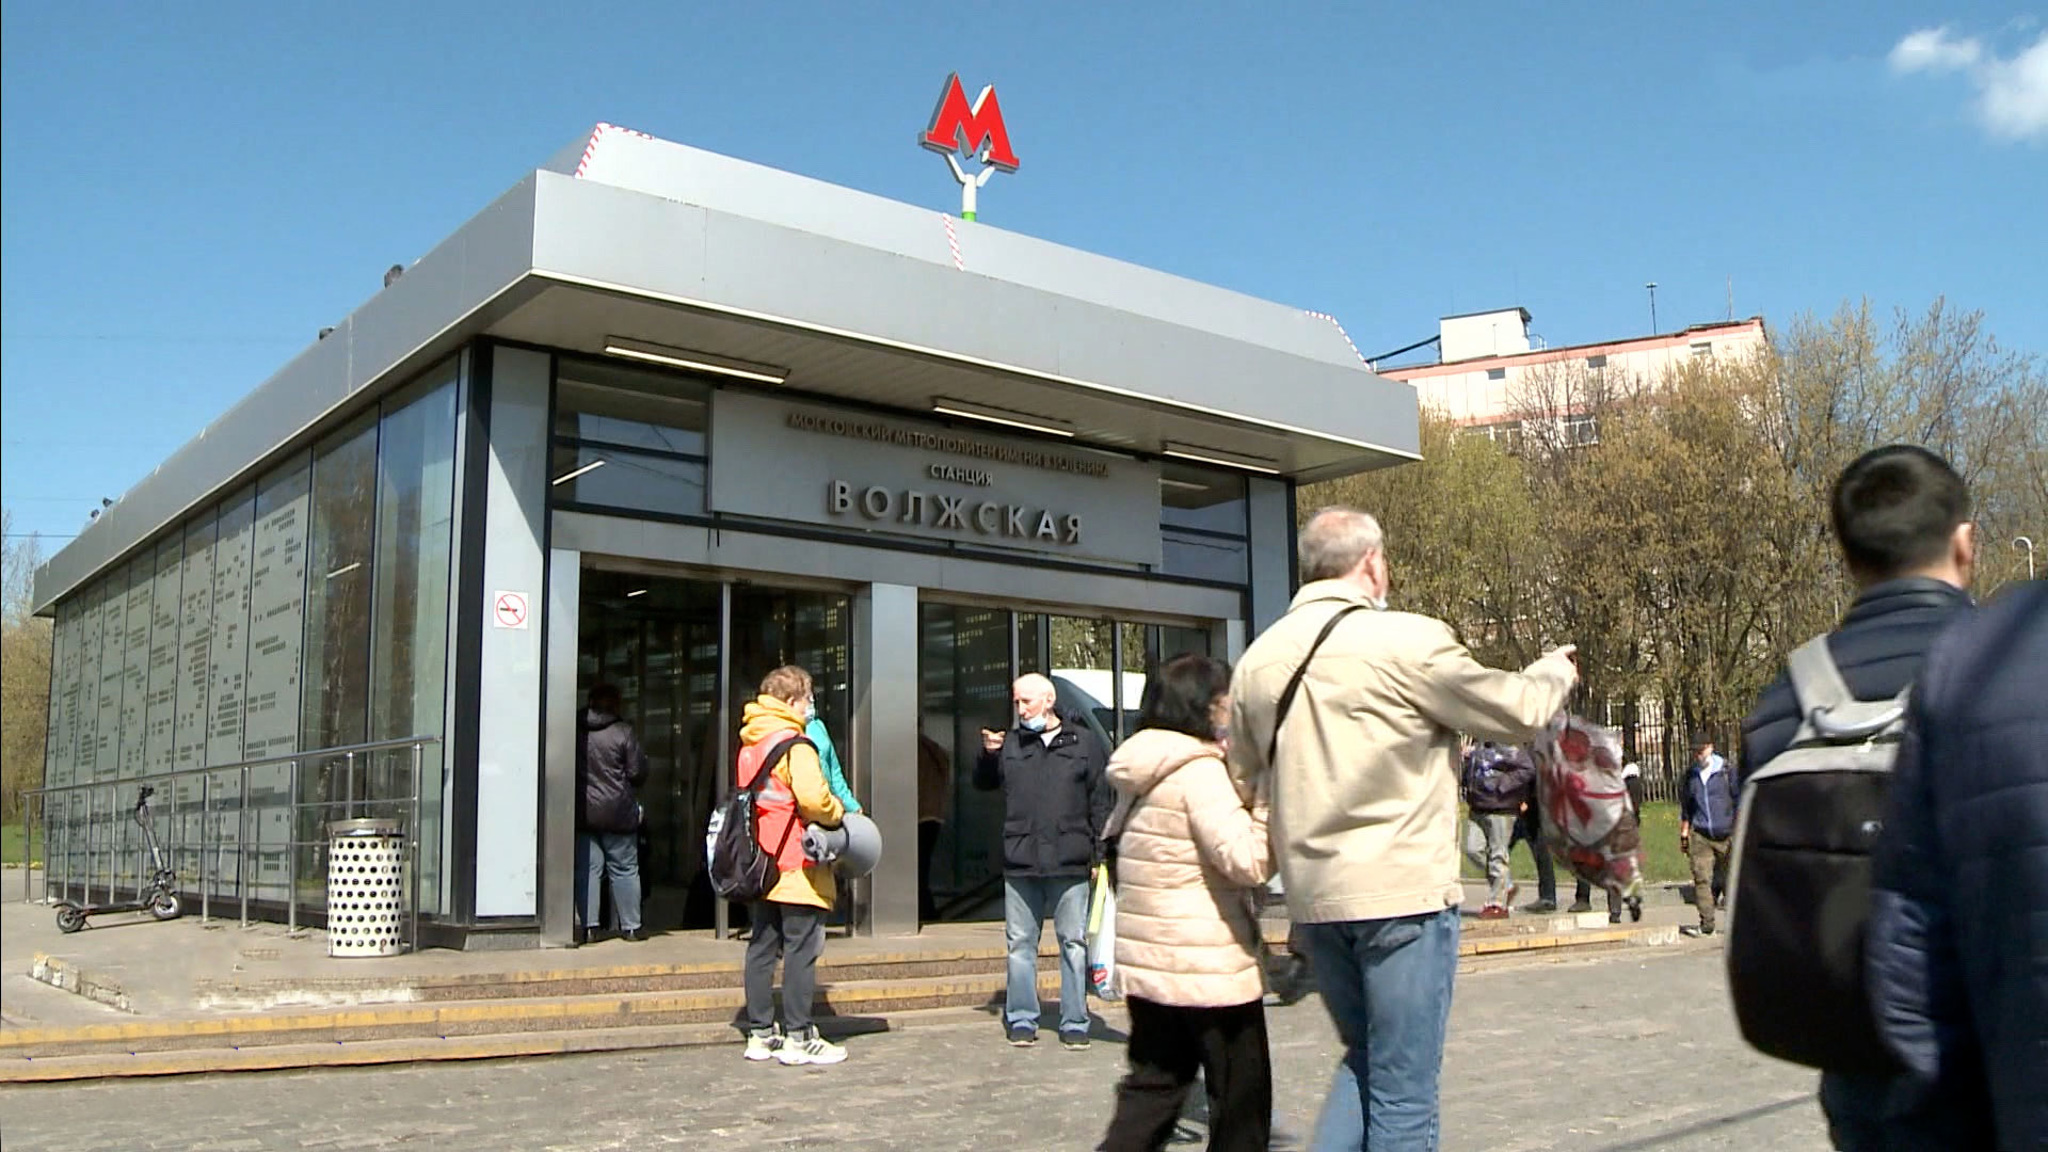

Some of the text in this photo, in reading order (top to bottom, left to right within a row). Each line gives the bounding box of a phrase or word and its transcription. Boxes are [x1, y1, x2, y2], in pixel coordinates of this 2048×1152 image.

[920, 71, 1020, 171] М
[788, 412, 892, 442] МОСКОВСКИЙ
[930, 464, 994, 487] СТАНЦИЯ
[830, 479, 1083, 544] ВОЛЖСКАЯ
